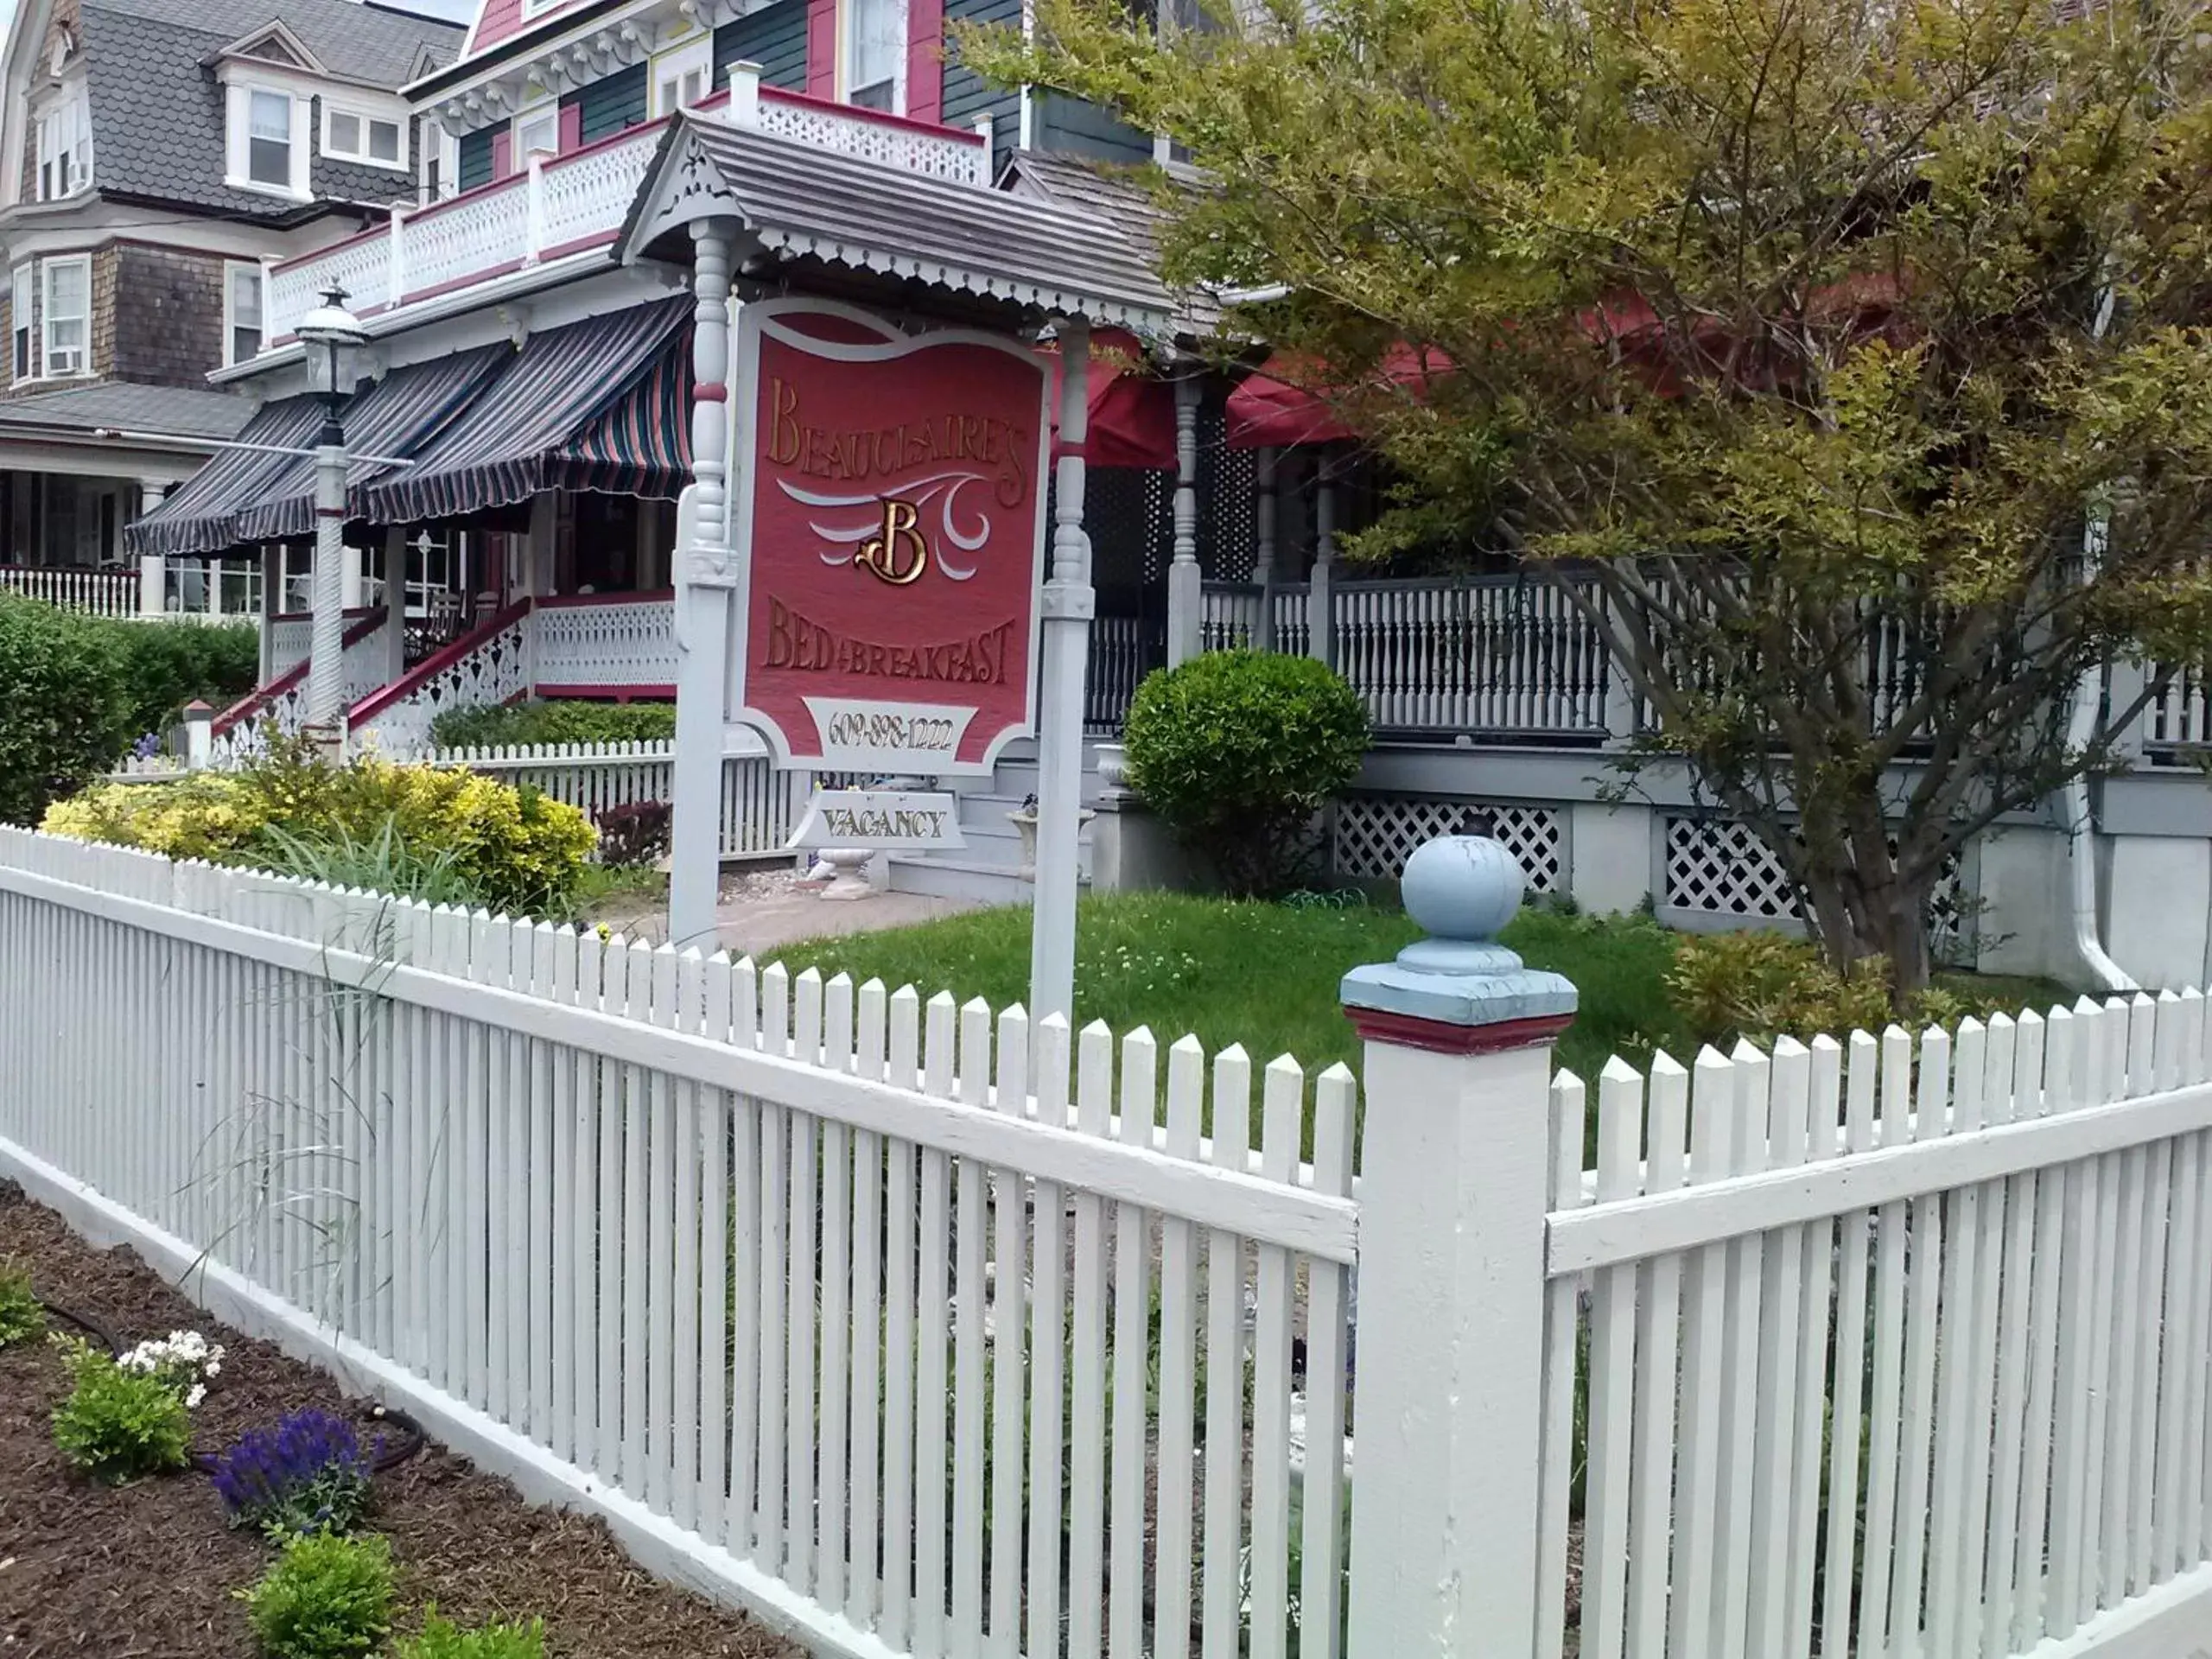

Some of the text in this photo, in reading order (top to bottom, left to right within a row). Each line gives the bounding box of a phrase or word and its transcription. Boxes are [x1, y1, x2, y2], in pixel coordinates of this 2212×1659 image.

[853, 495, 928, 586] B
[765, 593, 834, 671] BED
[848, 616, 1016, 684] BREAKFAST
[829, 711, 954, 750] 609-898-1222
[822, 808, 947, 839] VACANCY
